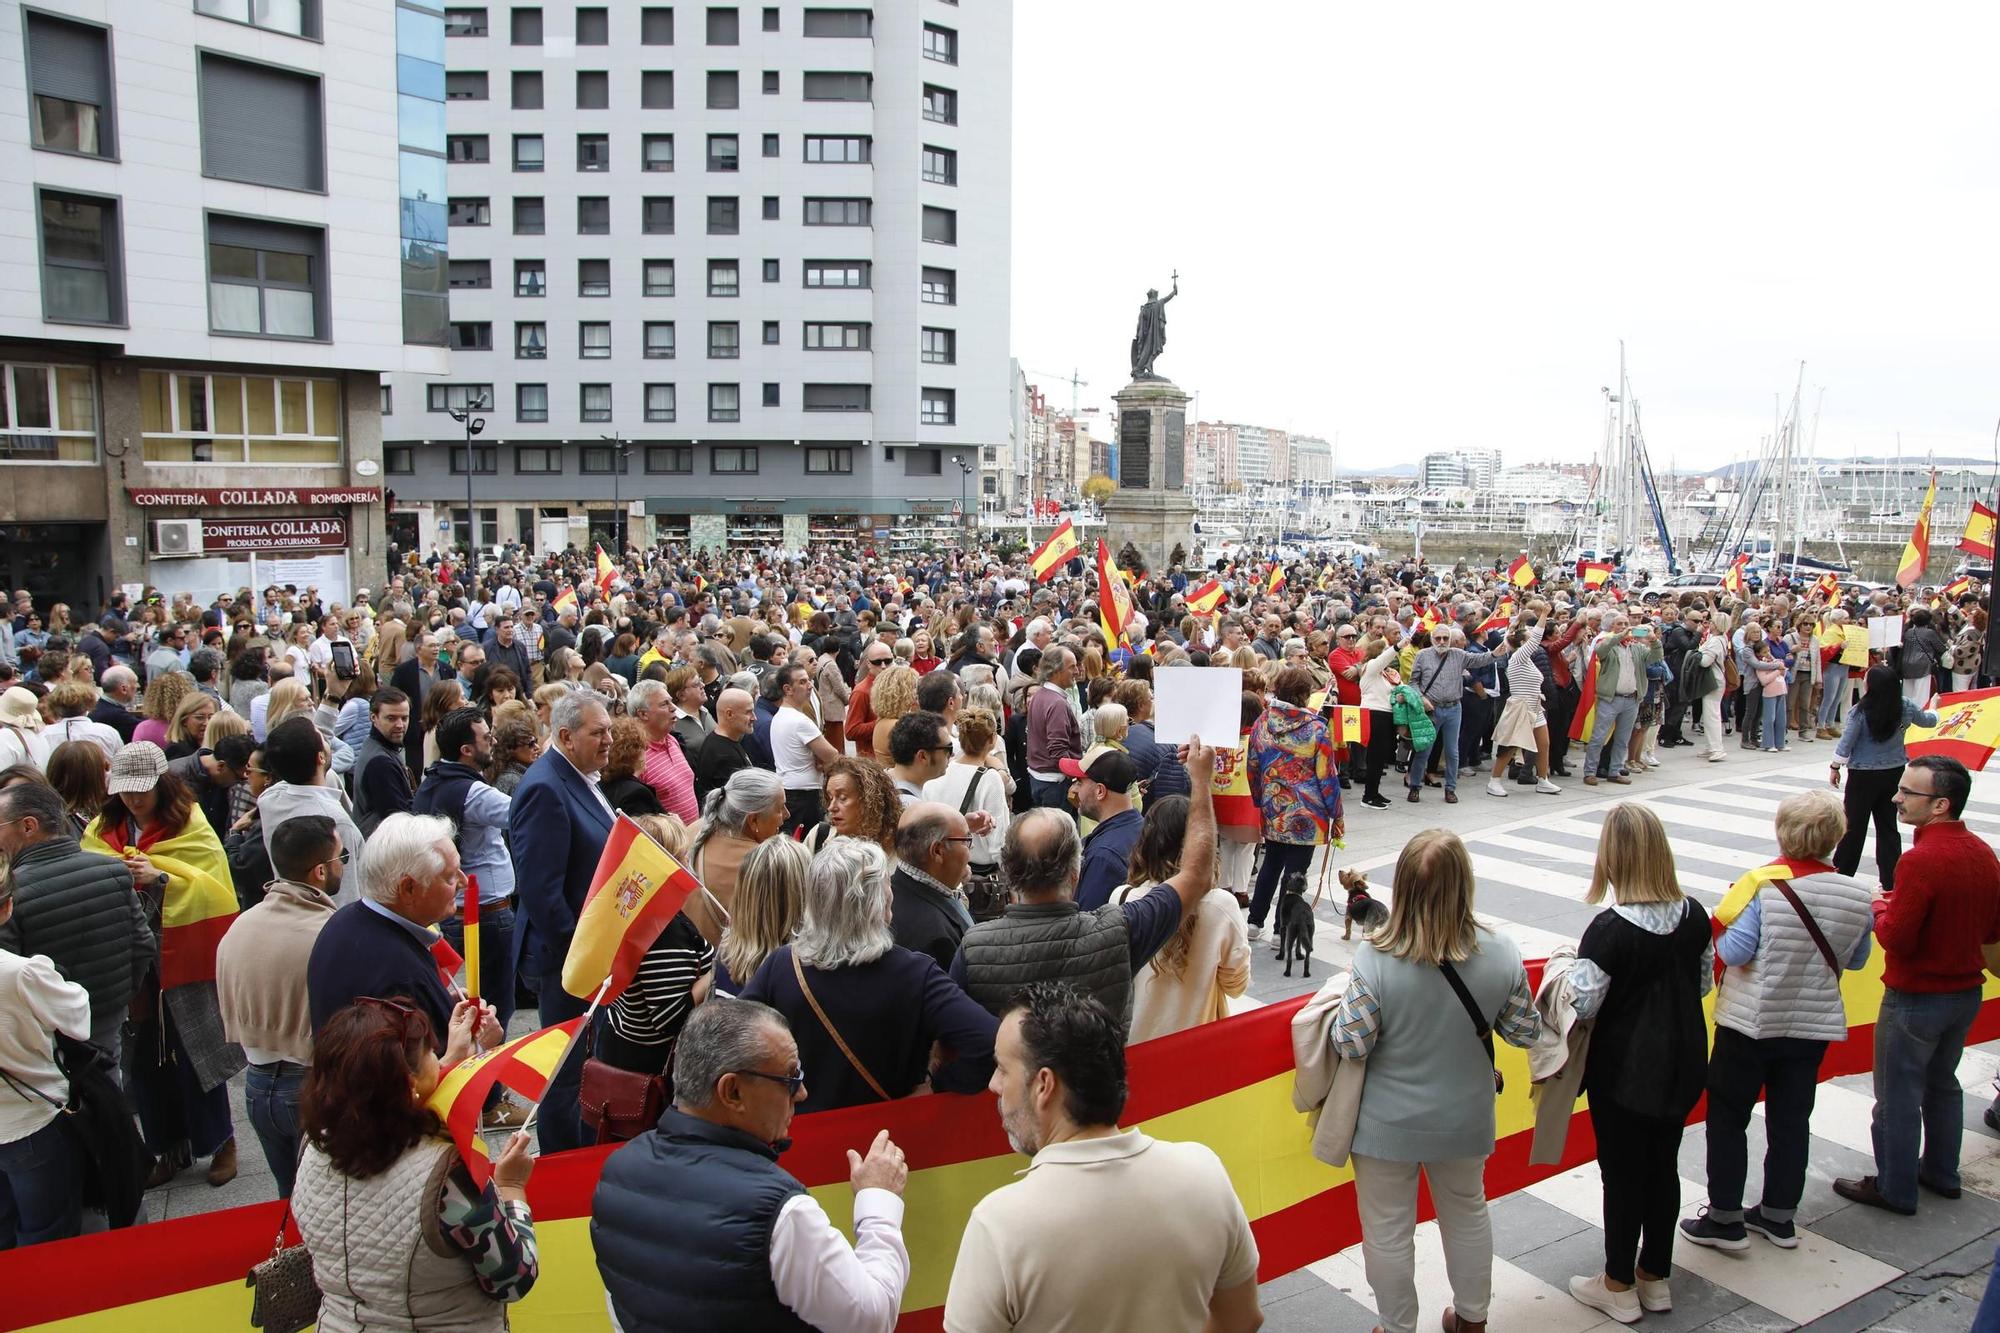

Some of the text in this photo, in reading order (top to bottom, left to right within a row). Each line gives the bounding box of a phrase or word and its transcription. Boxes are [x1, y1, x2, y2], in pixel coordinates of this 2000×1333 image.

[135, 490, 379, 506] CONFITERÍA COLLADA BOMBONERÍA
[202, 521, 342, 537] CONFITERIA COLLADA
[226, 536, 321, 548] PRODUCTOS ASTURIANOS
